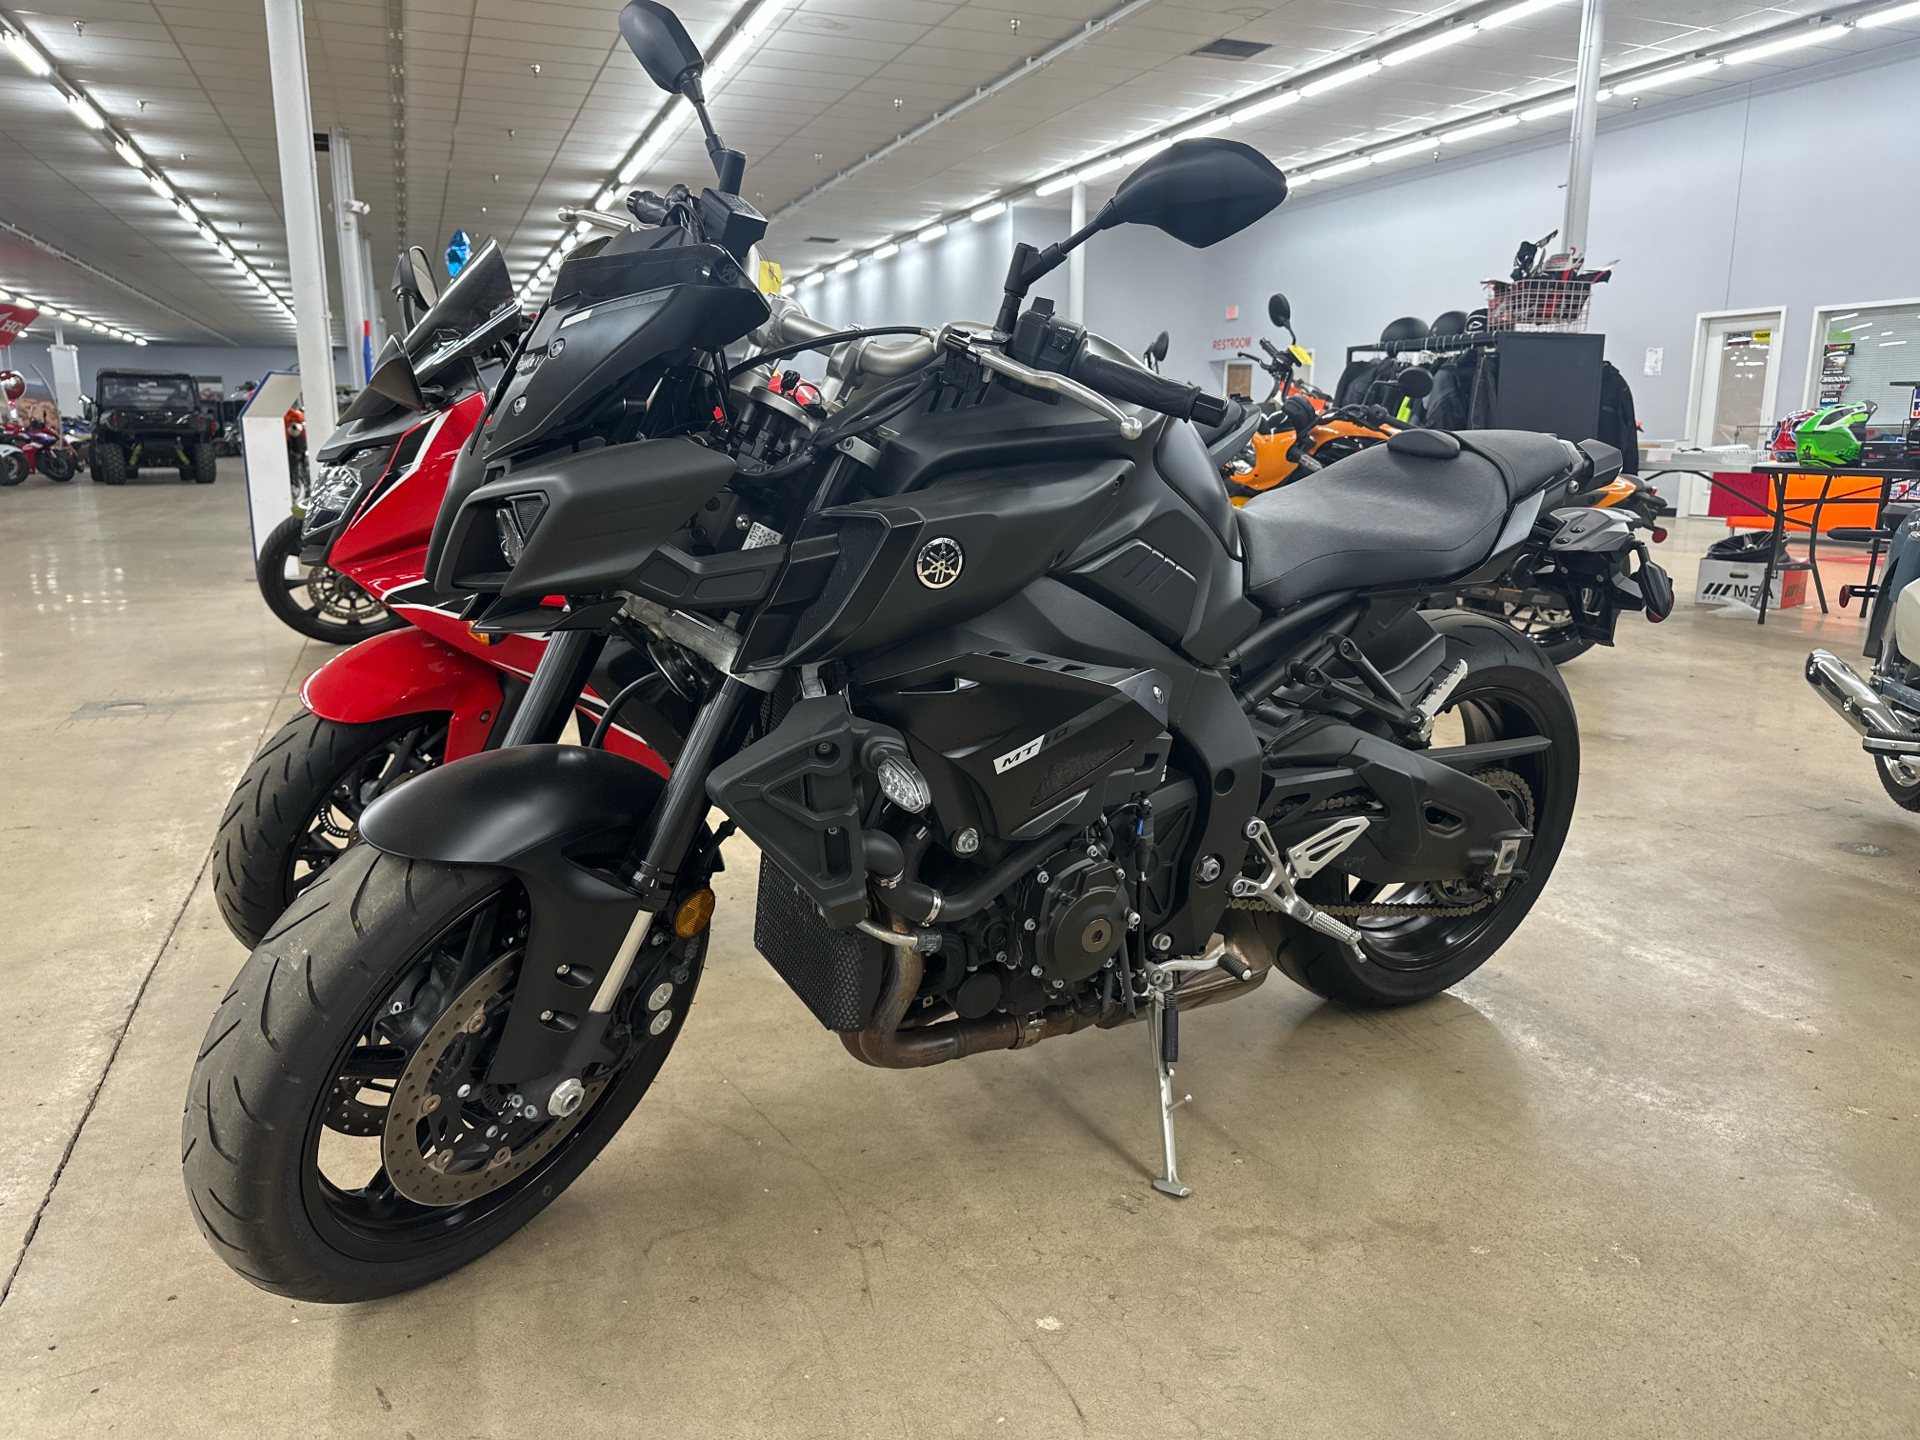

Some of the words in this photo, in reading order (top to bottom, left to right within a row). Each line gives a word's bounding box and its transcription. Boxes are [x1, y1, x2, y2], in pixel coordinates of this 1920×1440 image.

[1212, 337, 1251, 350] RESTROOM
[1002, 743, 1038, 768] MT
[1043, 726, 1069, 746] 10
